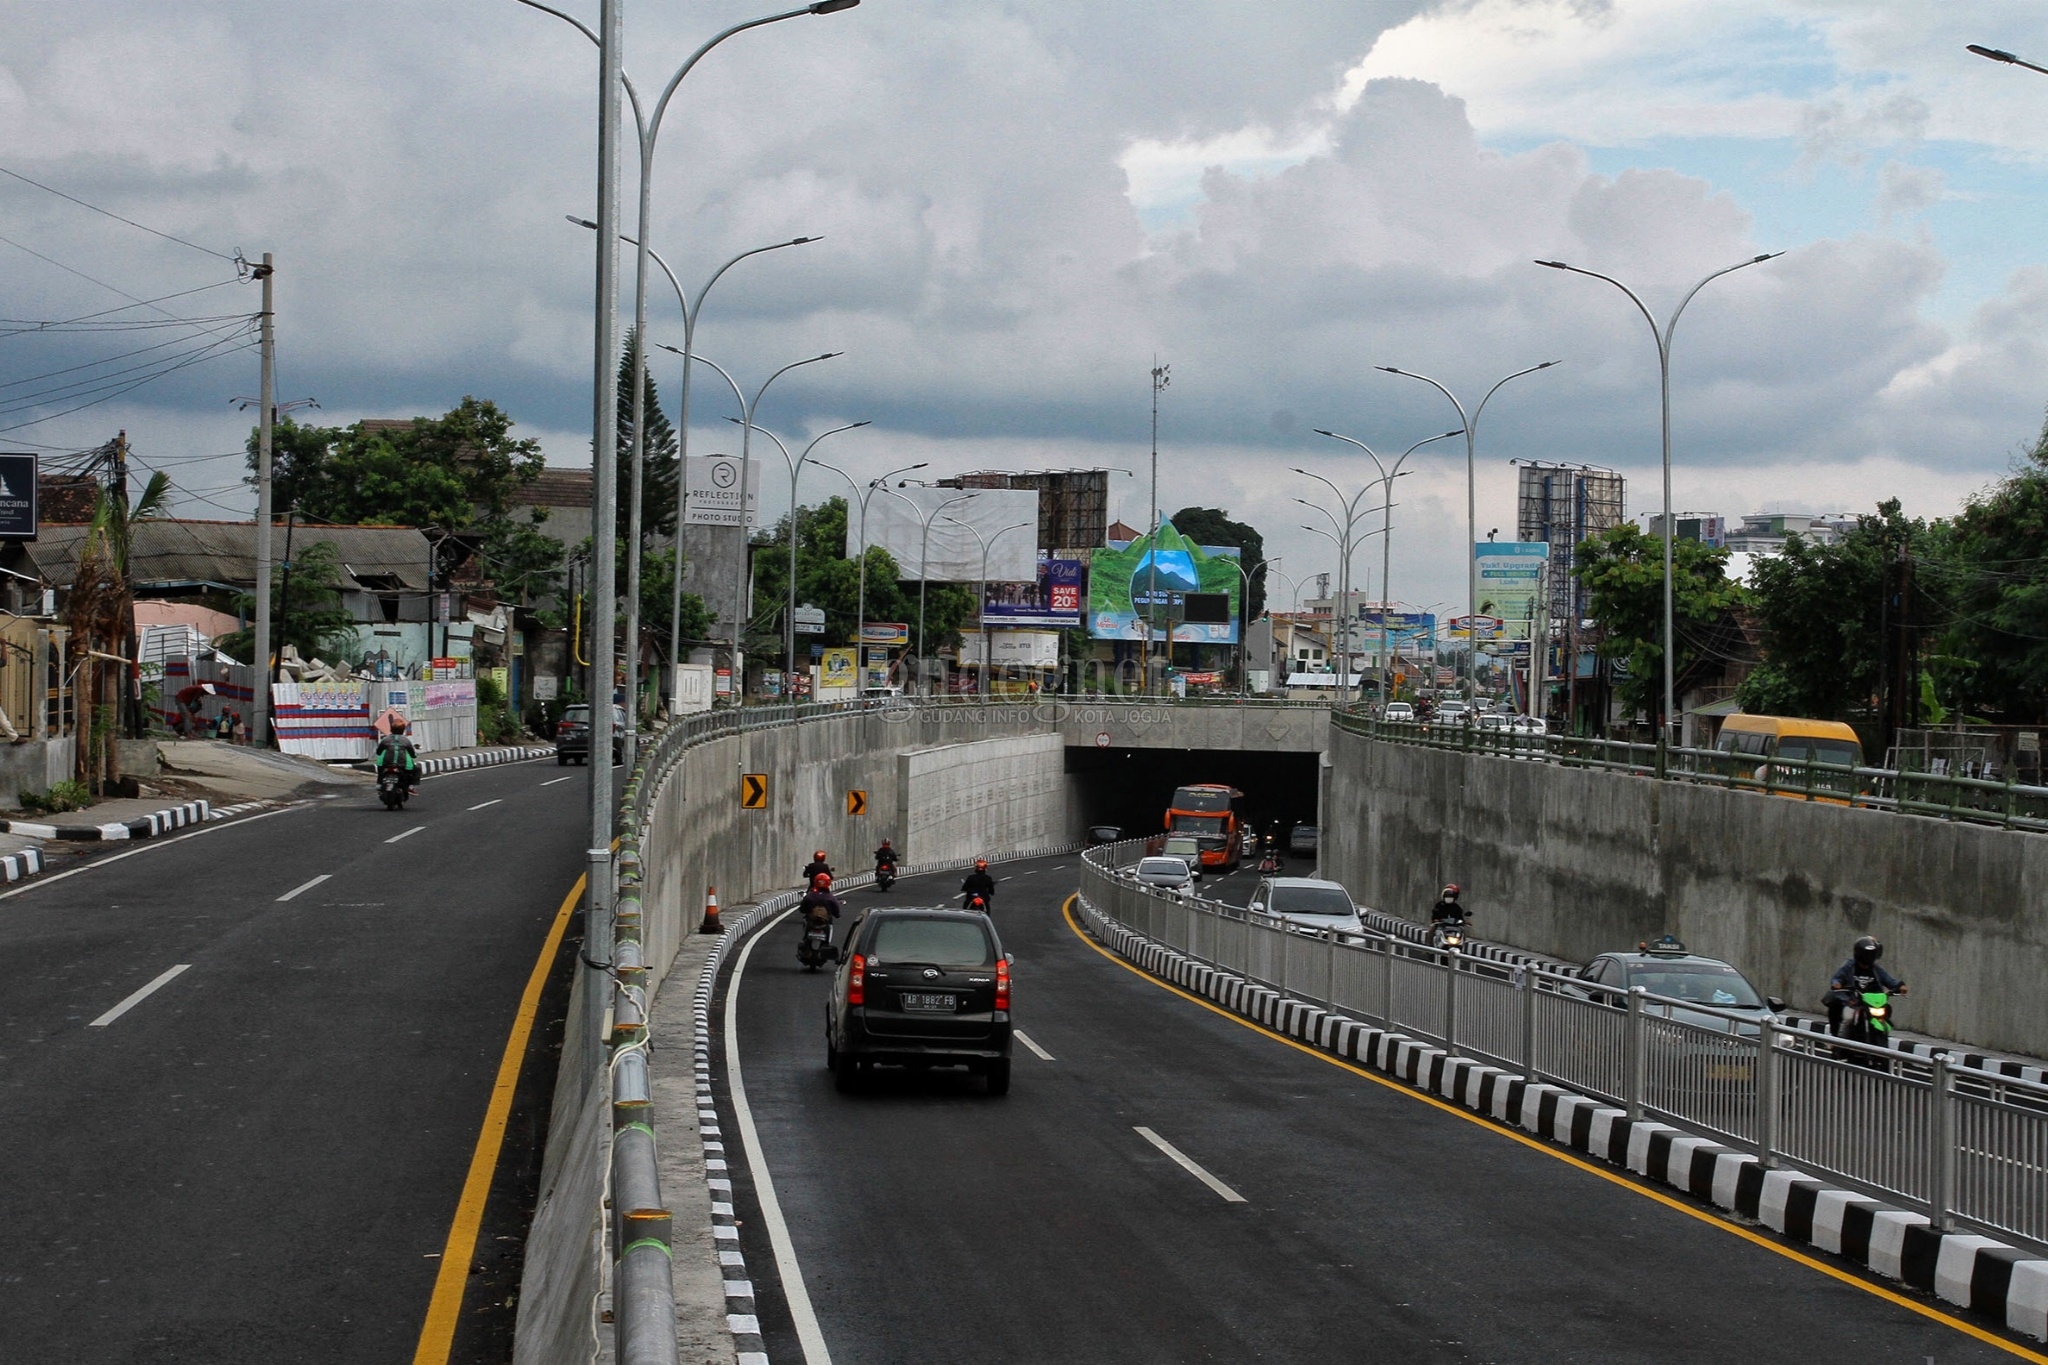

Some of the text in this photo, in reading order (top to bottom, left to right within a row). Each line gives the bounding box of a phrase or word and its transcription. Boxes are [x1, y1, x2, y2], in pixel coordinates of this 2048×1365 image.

[693, 490, 754, 501] REFLECTIN
[692, 513, 753, 523] PHOTO STUDO
[1053, 587, 1077, 595] SAVE
